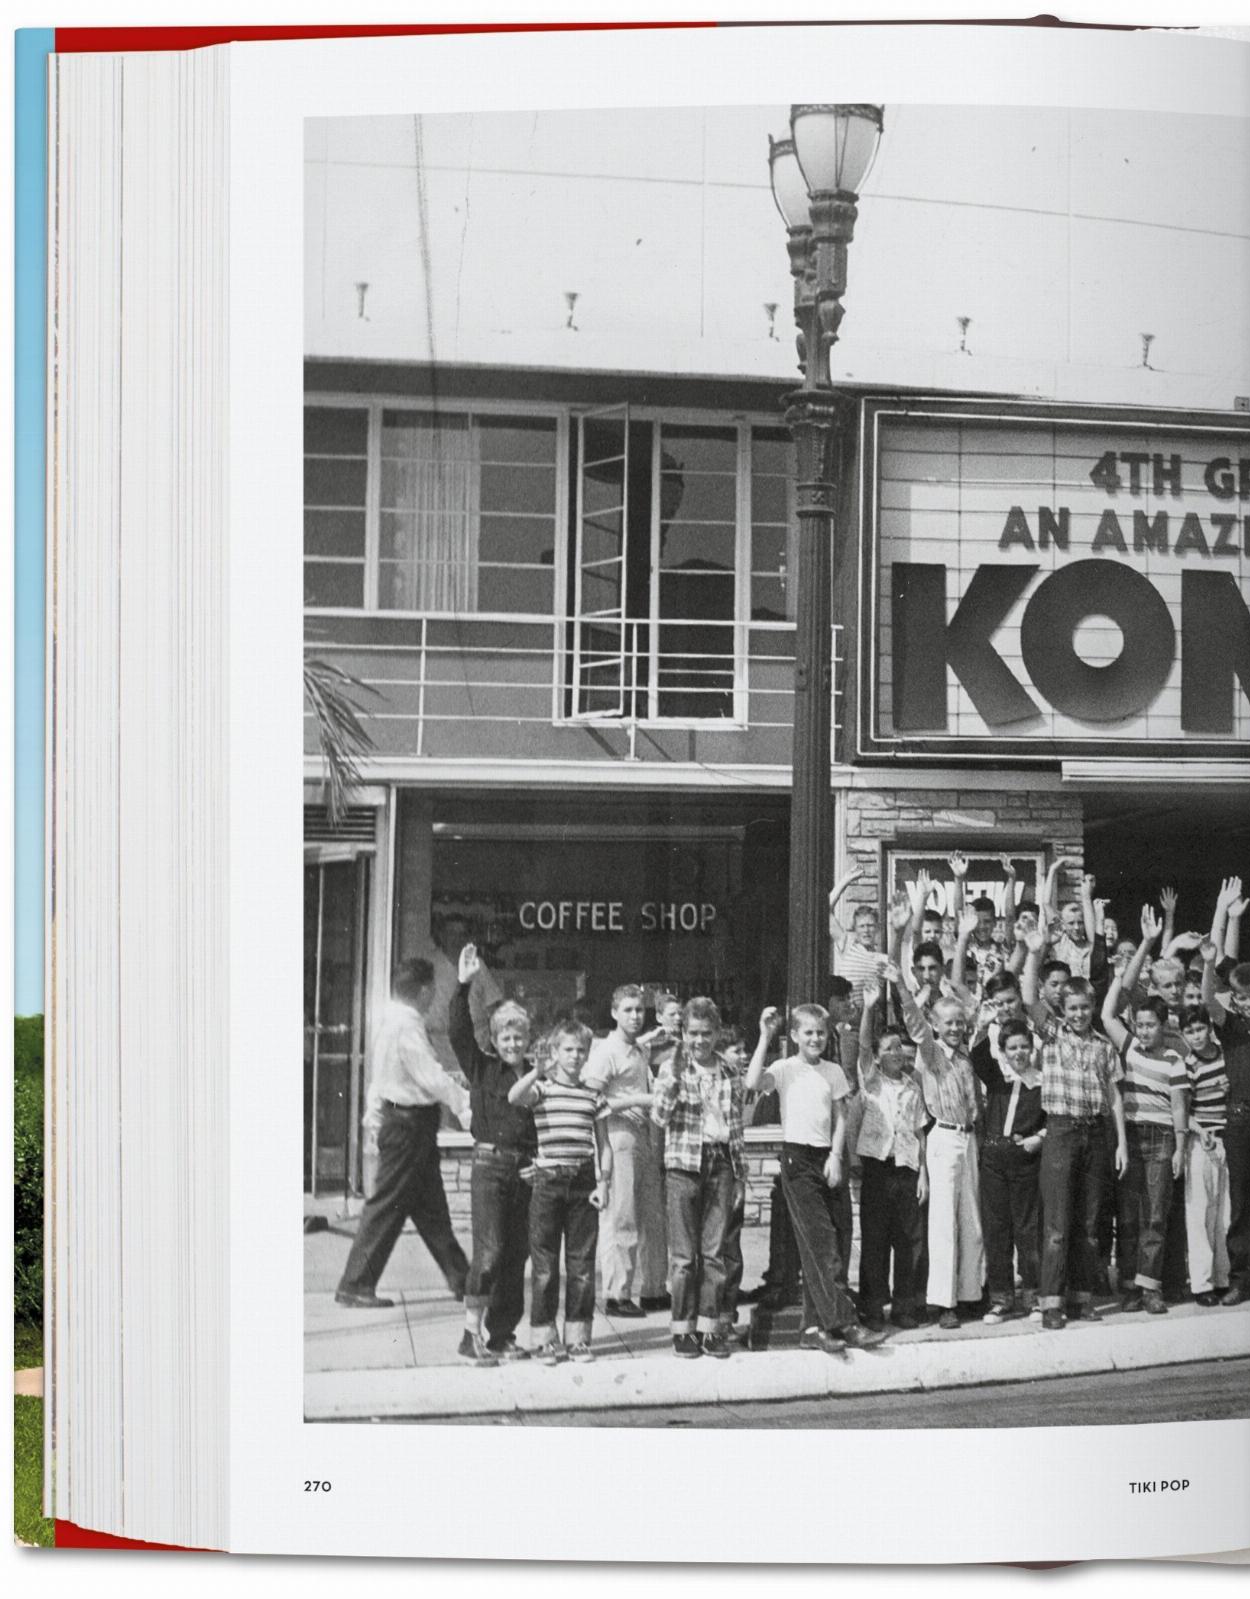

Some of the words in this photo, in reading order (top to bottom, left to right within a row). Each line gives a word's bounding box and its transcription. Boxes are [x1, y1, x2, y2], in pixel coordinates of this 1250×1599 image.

[1090, 451, 1182, 496] 4TH
[998, 506, 1070, 550] AN
[519, 902, 624, 931] COFFEE
[641, 903, 717, 931] SHOP
[304, 1480, 332, 1492] 270
[1129, 1481, 1156, 1494] TIKI
[1161, 1479, 1190, 1492] POP
